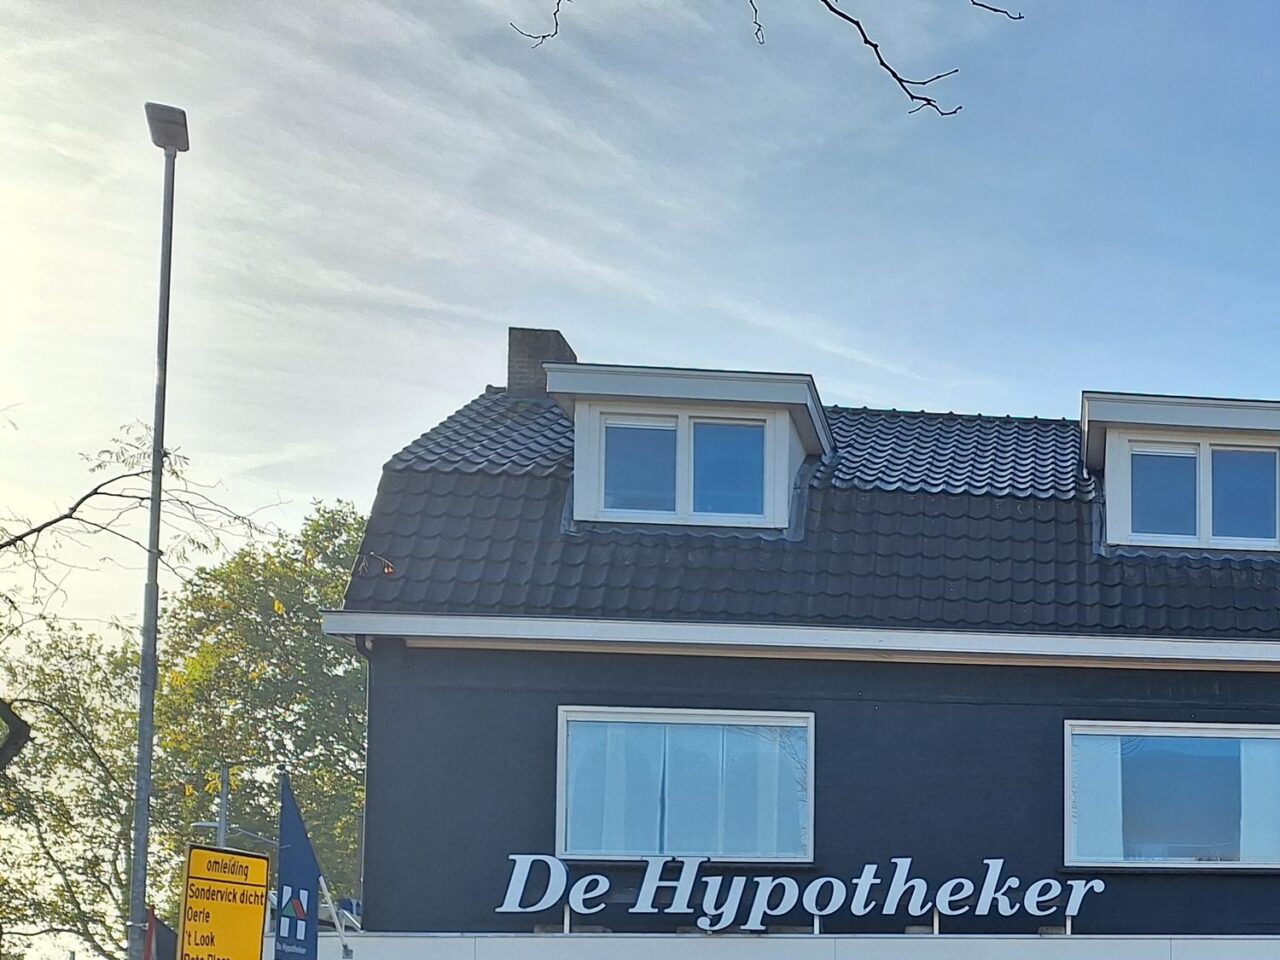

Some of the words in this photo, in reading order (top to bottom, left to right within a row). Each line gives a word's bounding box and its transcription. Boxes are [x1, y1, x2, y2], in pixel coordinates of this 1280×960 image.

[206, 858, 249, 881] omleiding
[188, 883, 238, 904] Sondervick
[239, 889, 265, 906] dicht
[495, 854, 610, 914] De
[628, 856, 1105, 930] Hypotheker
[186, 906, 211, 923] Oerle
[185, 930, 192, 946] 't
[194, 931, 216, 947] Look
